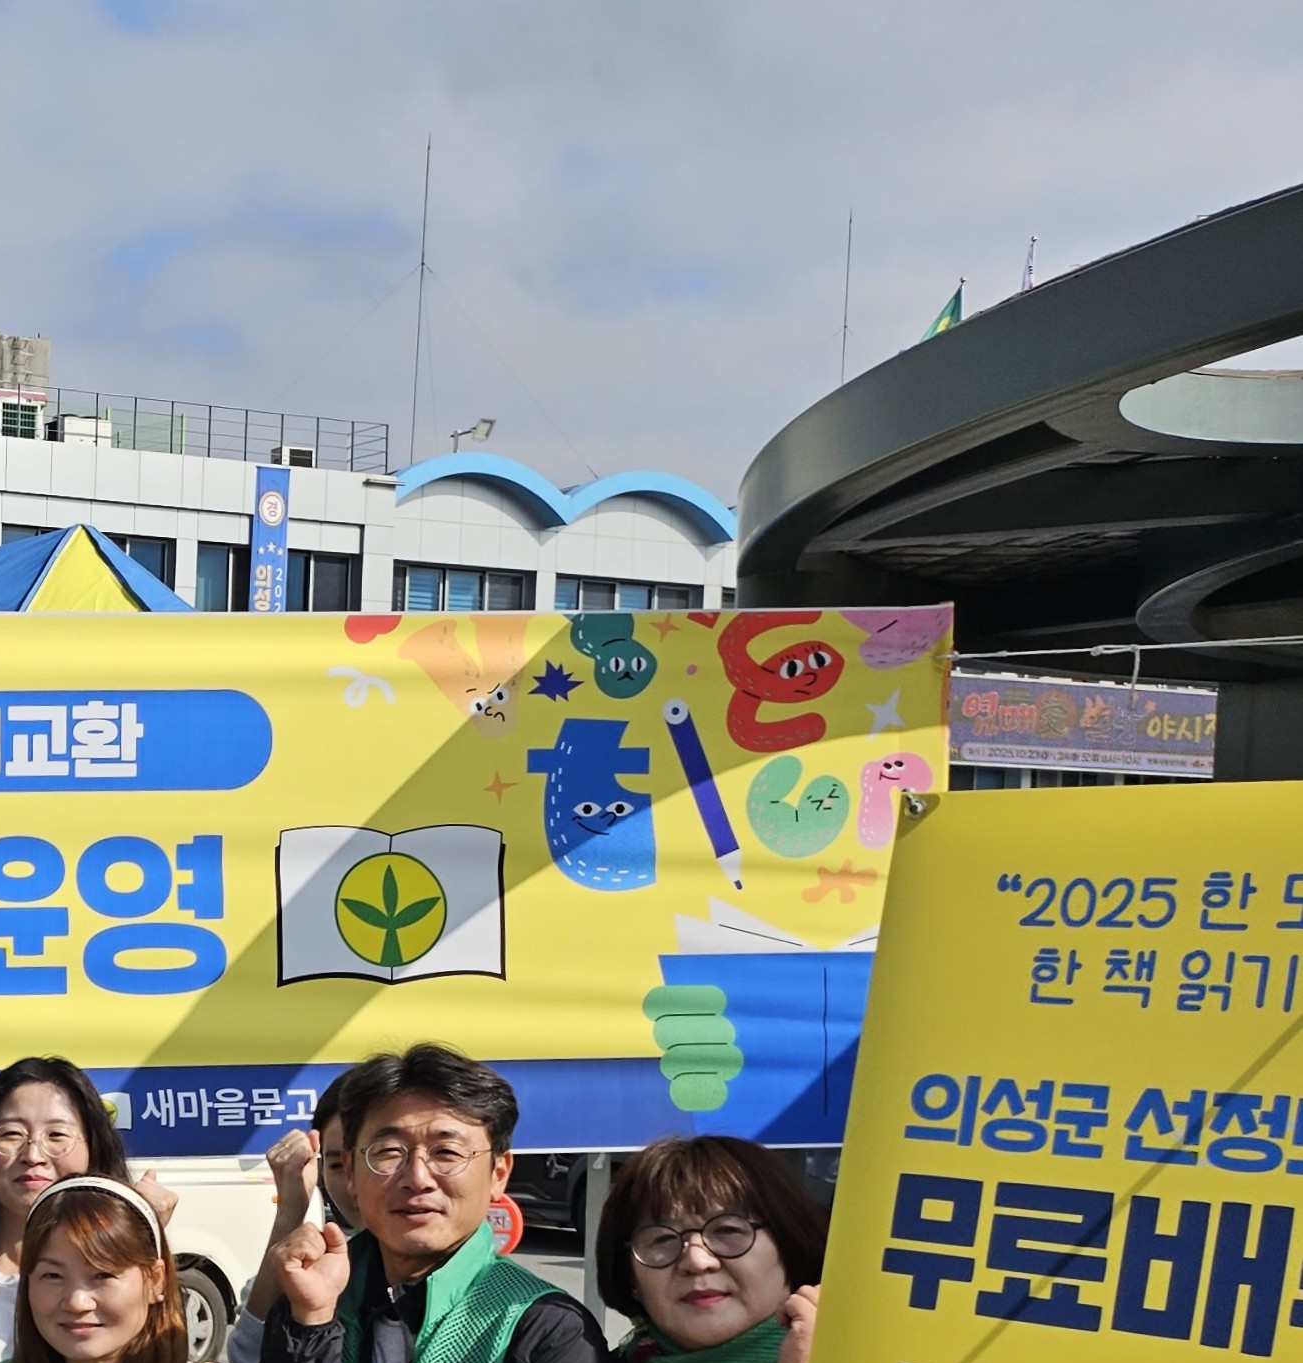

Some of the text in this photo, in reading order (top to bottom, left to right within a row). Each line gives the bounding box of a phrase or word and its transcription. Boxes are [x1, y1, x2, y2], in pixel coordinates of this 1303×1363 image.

[253, 564, 273, 612] 의성
[1199, 871, 1257, 931] 한
[1030, 948, 1300, 1013] 한 책 읽기
[904, 1073, 1303, 1175] 의성군 선정
[881, 1173, 1303, 1358] 무료배
